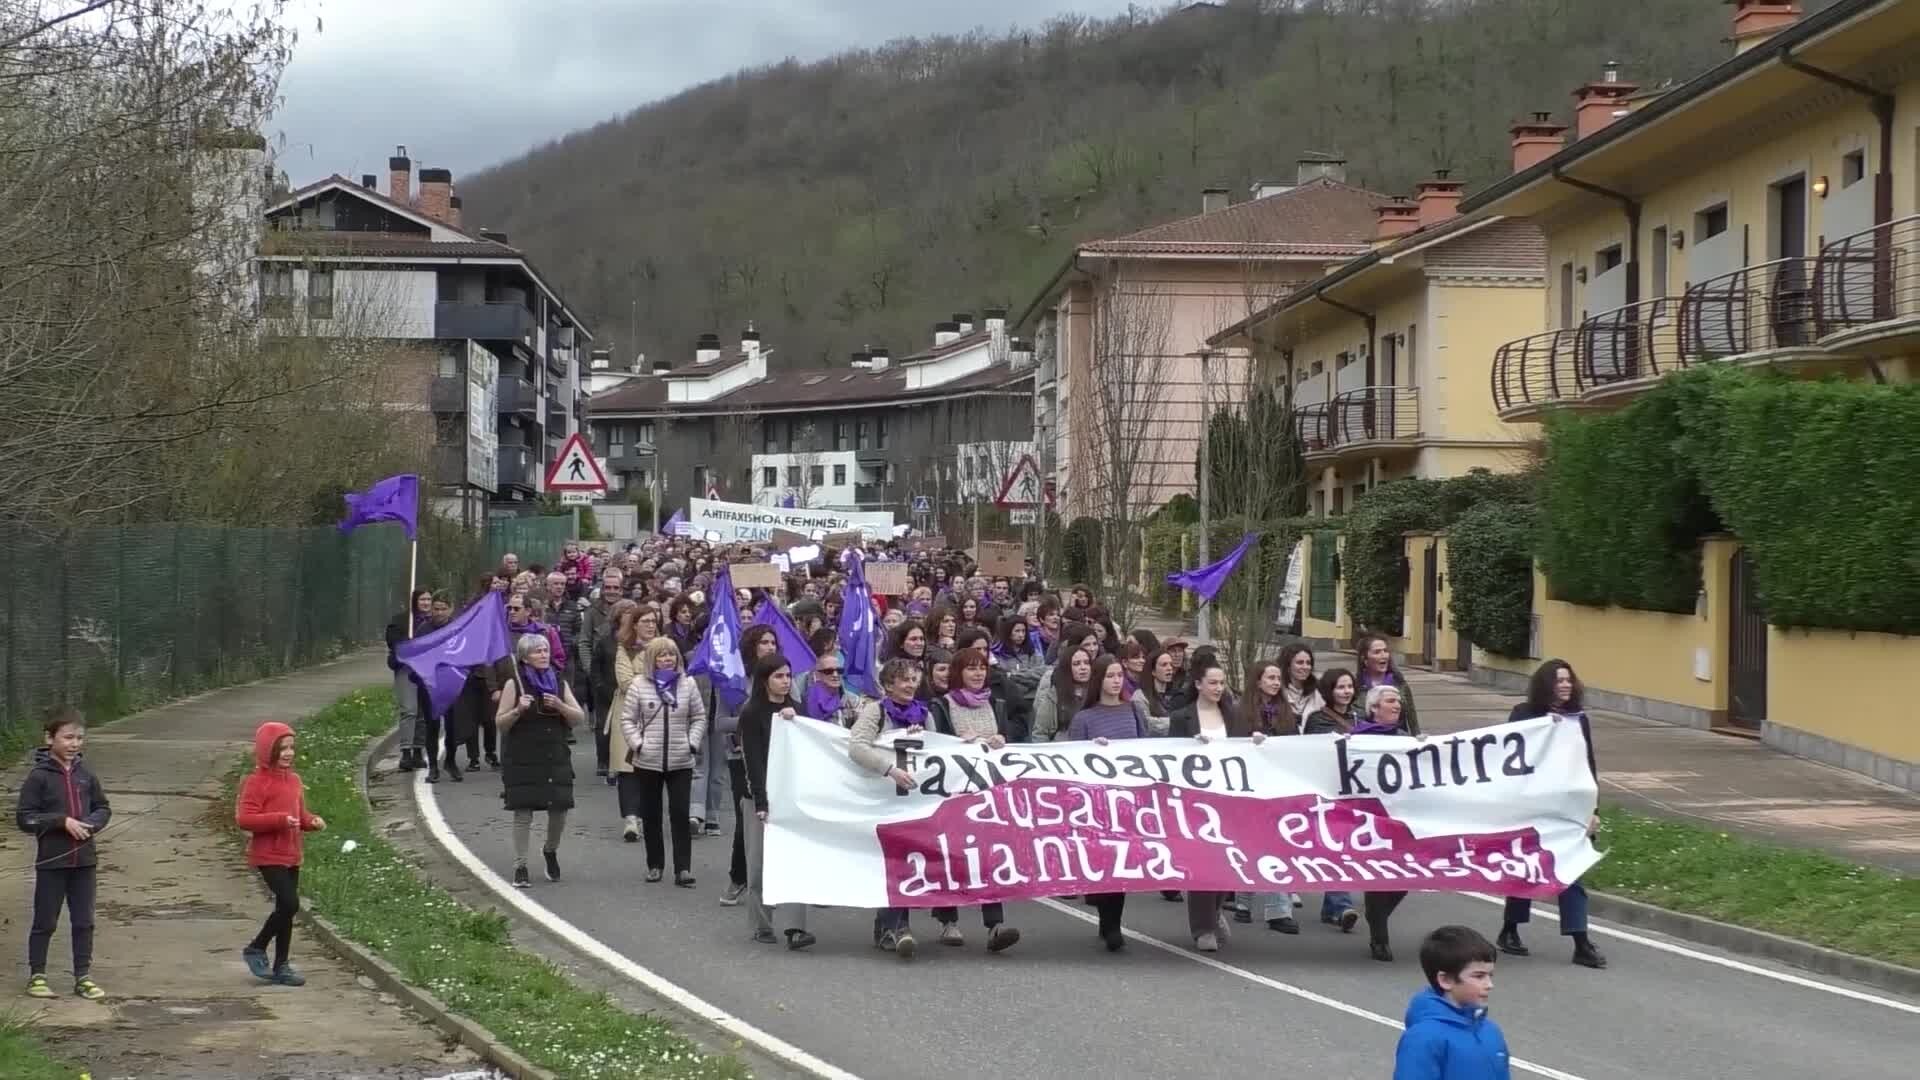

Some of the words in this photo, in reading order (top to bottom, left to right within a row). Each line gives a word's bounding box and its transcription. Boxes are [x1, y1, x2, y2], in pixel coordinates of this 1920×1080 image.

[893, 738, 1255, 797] Faxismoaren
[1334, 731, 1535, 796] kontra
[966, 785, 1235, 846] ausardia
[1278, 795, 1393, 852] eta
[899, 827, 1185, 898] aliantza
